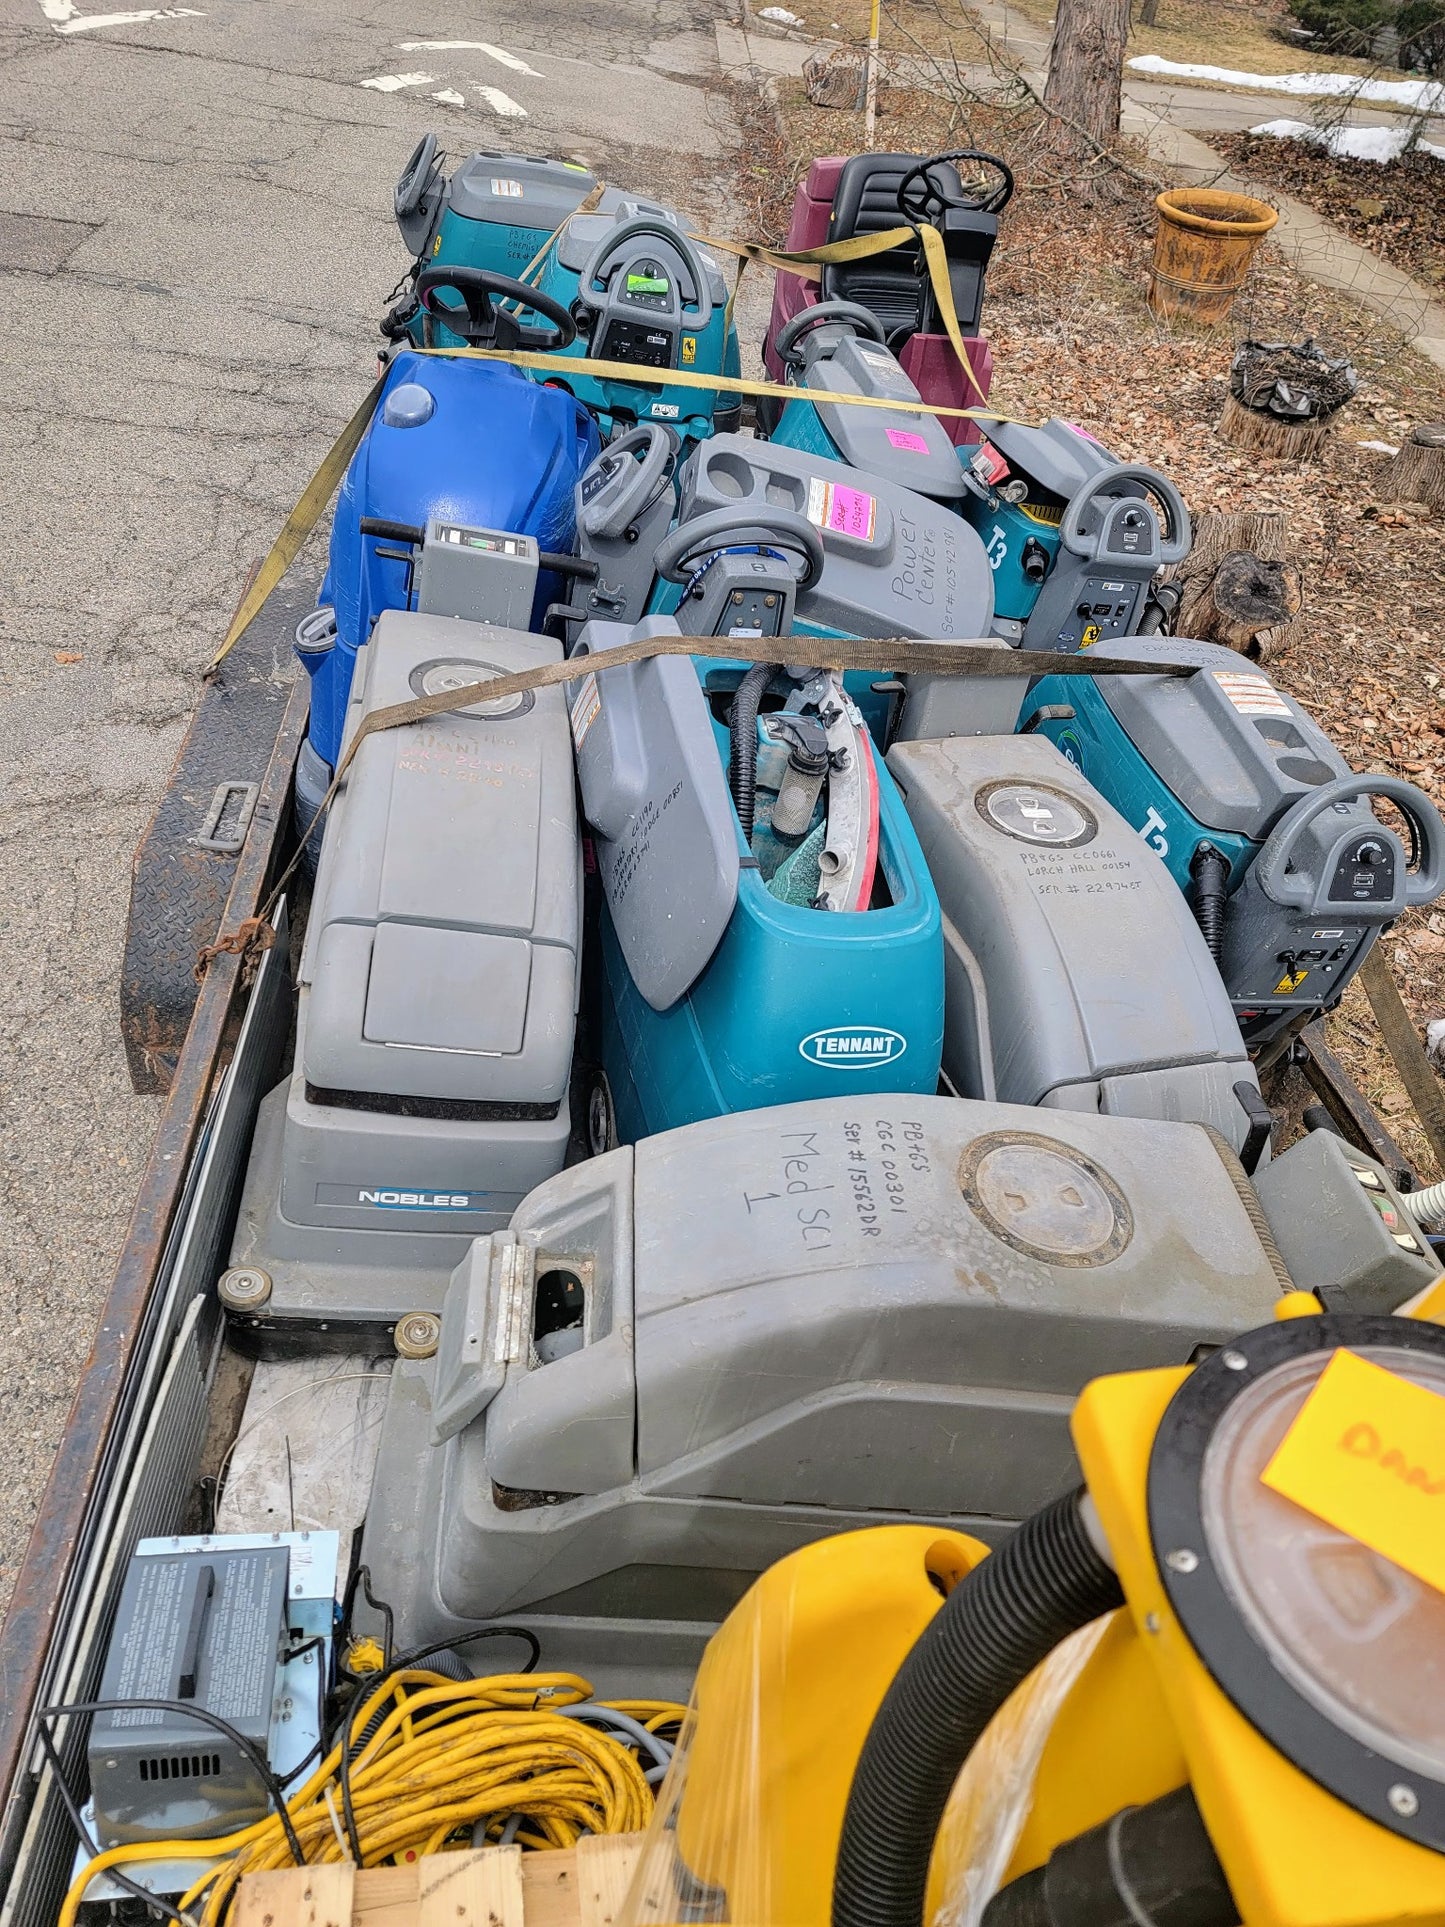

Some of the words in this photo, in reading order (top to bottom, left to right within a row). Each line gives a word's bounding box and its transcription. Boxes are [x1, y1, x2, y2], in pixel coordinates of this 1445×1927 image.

[986, 524, 1007, 569] T3
[1027, 865, 1064, 877] LORCH
[1069, 864, 1096, 874] HALL
[814, 1036, 896, 1058] TENNANT
[780, 1133, 835, 1195] Med
[358, 1190, 469, 1207] NOBLES
